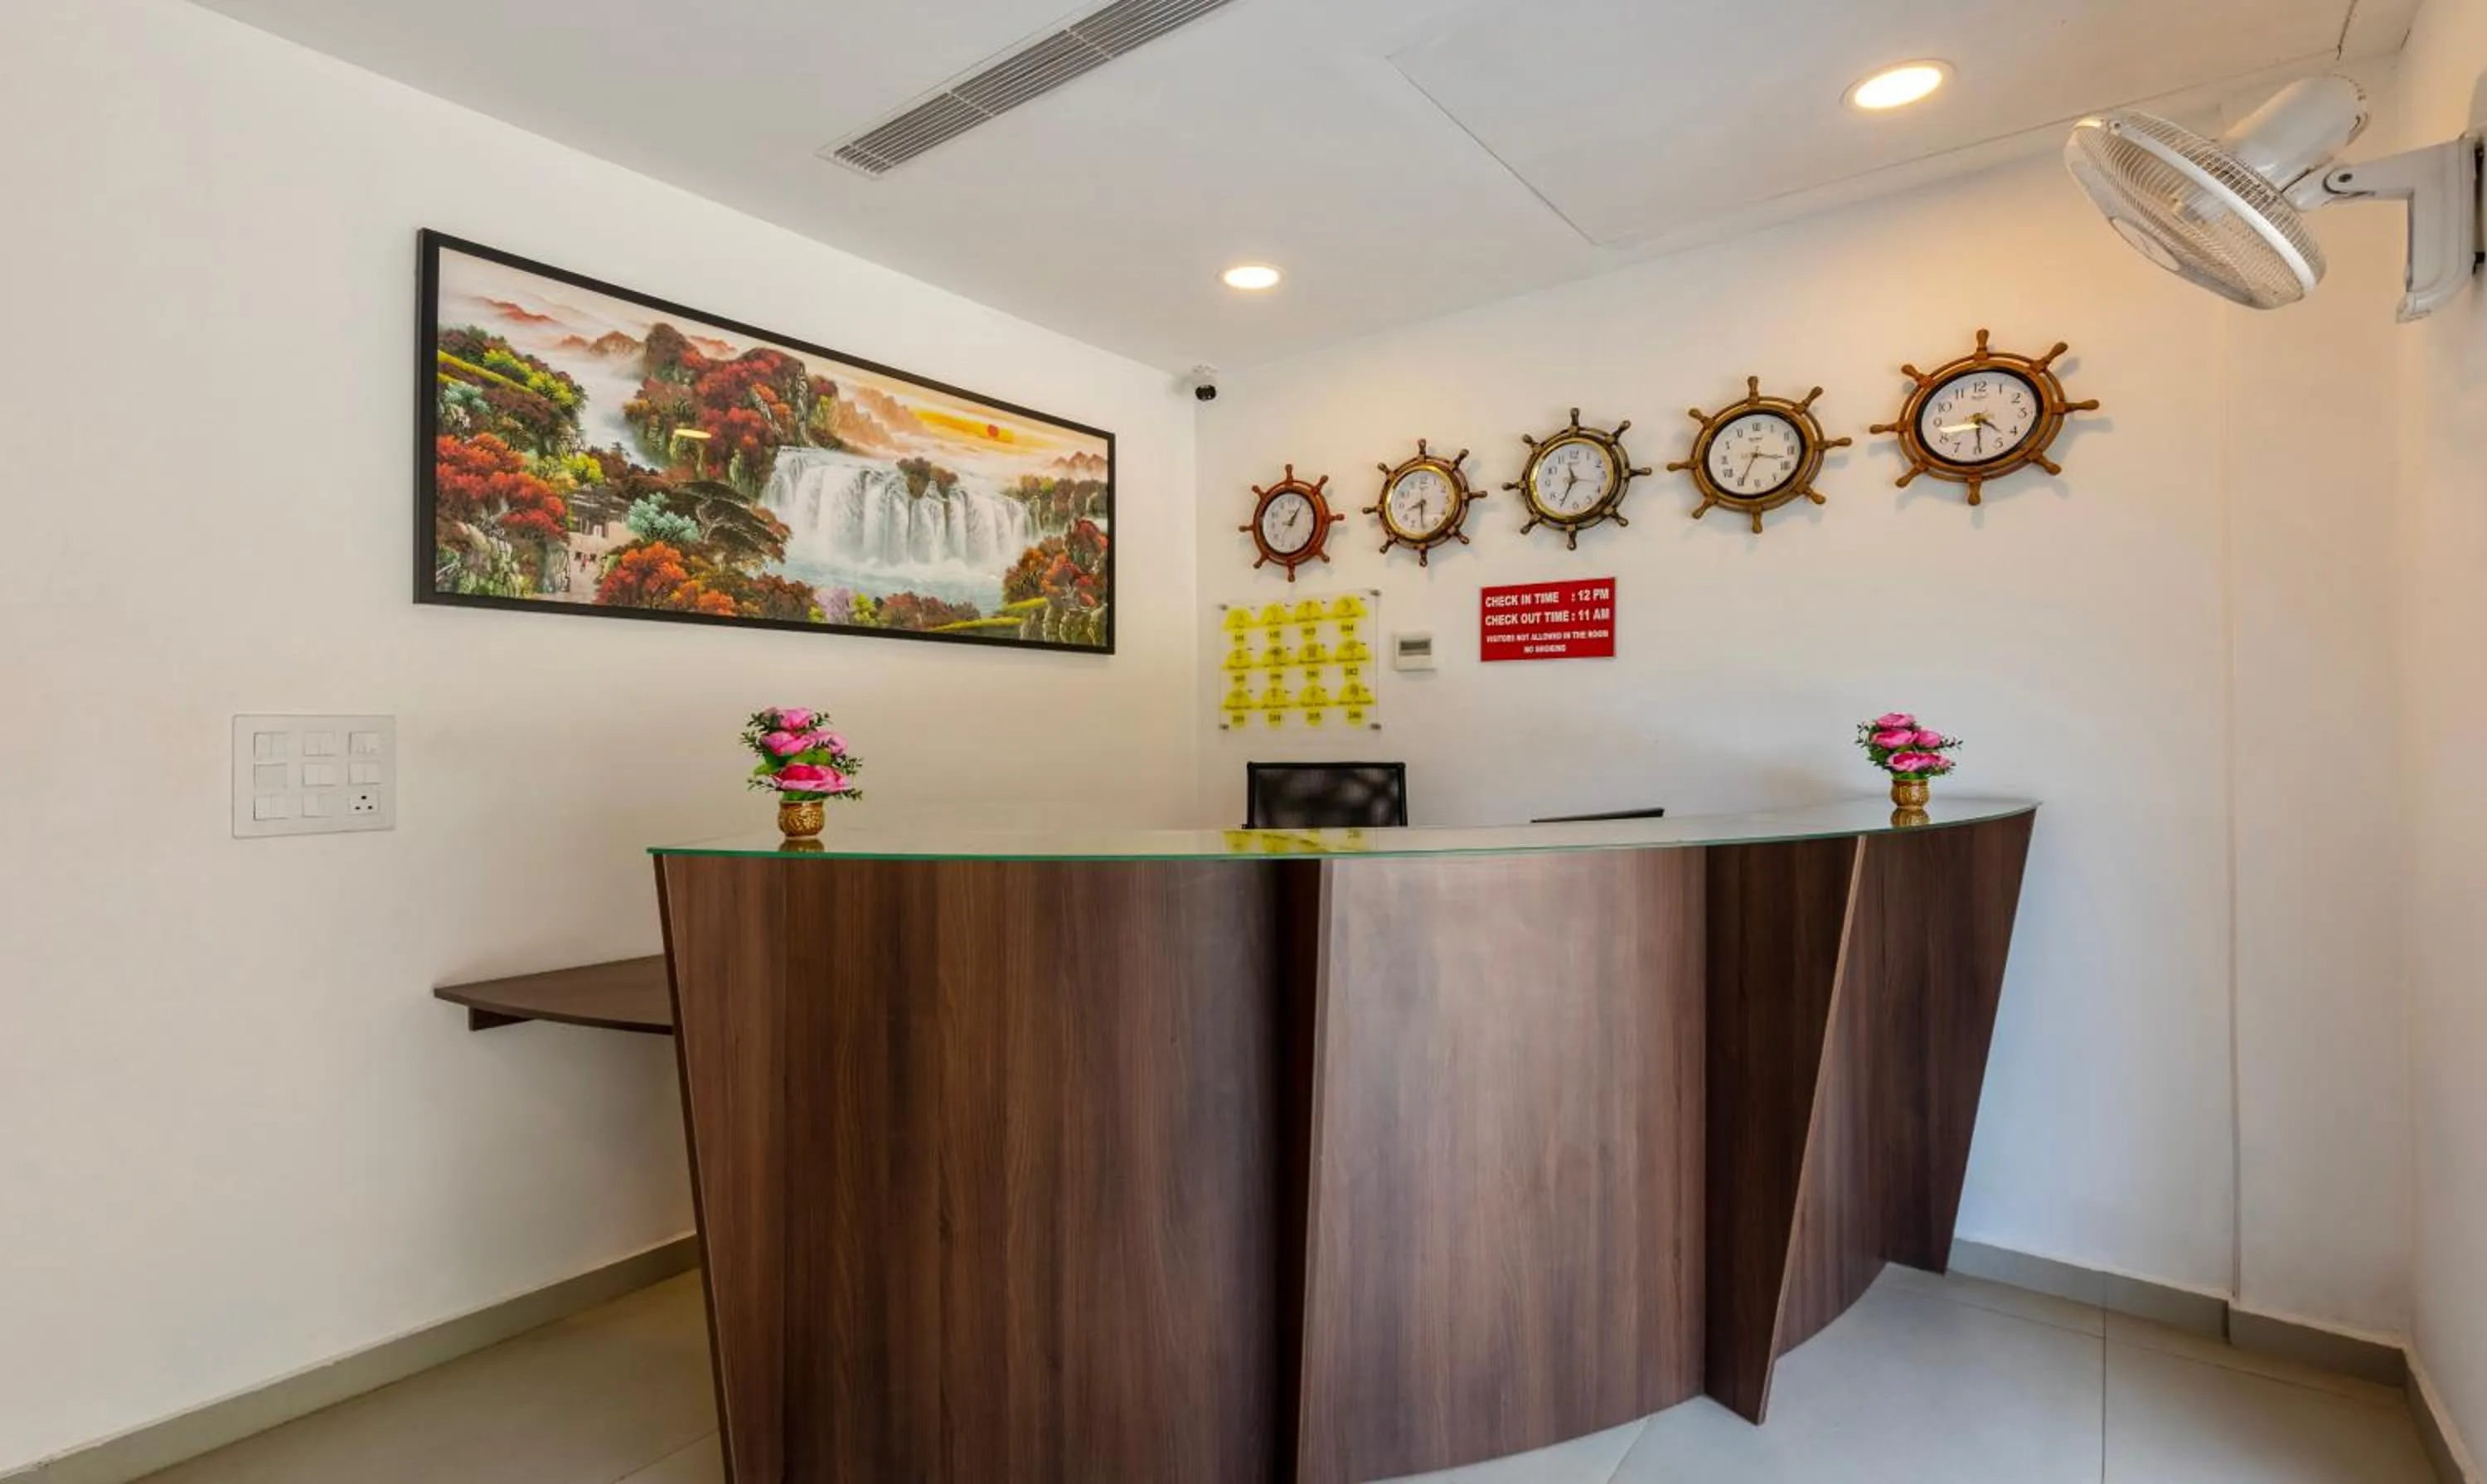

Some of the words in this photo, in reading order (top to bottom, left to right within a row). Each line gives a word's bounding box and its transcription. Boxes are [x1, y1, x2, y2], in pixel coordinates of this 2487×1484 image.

[1973, 381, 1987, 392] 12
[1997, 384, 2002, 395] 1
[1956, 389, 1964, 400] 11
[2011, 392, 2021, 404] 2
[1937, 402, 1952, 413] 10
[2018, 408, 2028, 418] 3
[1933, 417, 1942, 427] 9
[2009, 426, 2018, 436] 4
[1939, 434, 1948, 444] 8
[1995, 438, 2004, 449] 5
[1953, 443, 1961, 453] 7
[1486, 595, 1518, 607] CHECK
[1521, 594, 1531, 604] IN
[1534, 592, 1559, 604] TIME
[1578, 589, 1591, 600] 12
[1593, 589, 1609, 600] PM
[1486, 614, 1518, 625] CHECK
[1521, 613, 1541, 623] OUT
[1544, 611, 1568, 622] TIME
[1578, 610, 1589, 620] 11
[1593, 609, 1609, 620] AM
[1531, 633, 1562, 641] ALLOWED
